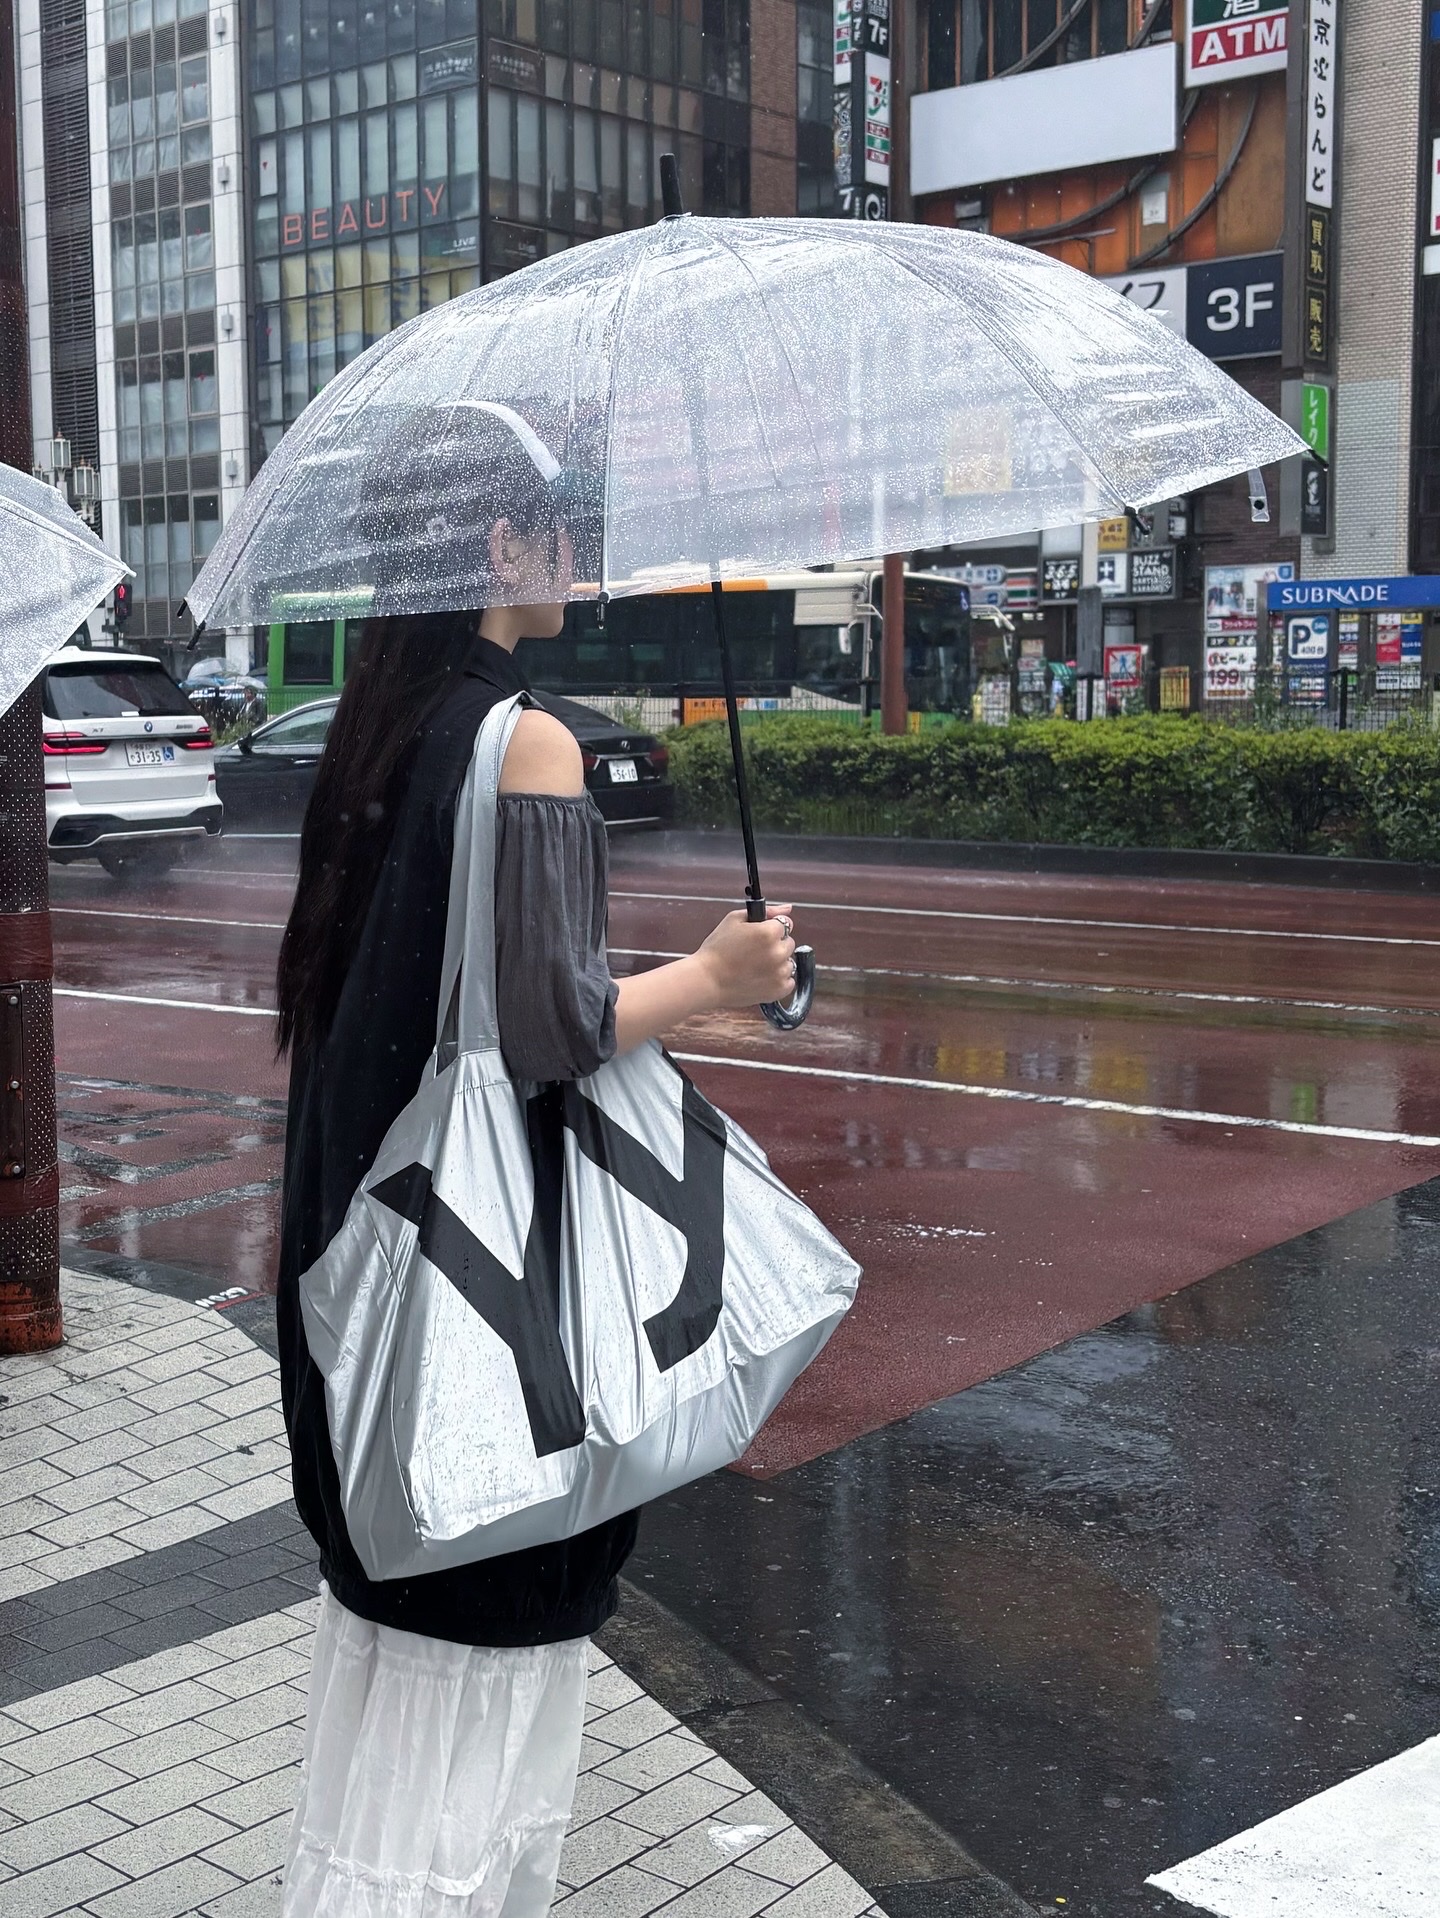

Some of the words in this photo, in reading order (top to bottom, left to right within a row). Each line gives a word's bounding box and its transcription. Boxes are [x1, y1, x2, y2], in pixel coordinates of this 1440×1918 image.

[1198, 17, 1286, 64] ATM
[283, 183, 444, 245] BEAUTY
[1206, 281, 1275, 332] 3F
[1308, 389, 1319, 446] レイク
[1281, 585, 1389, 605] SUBNADE
[1291, 624, 1311, 655] P
[1208, 669, 1240, 685] 199
